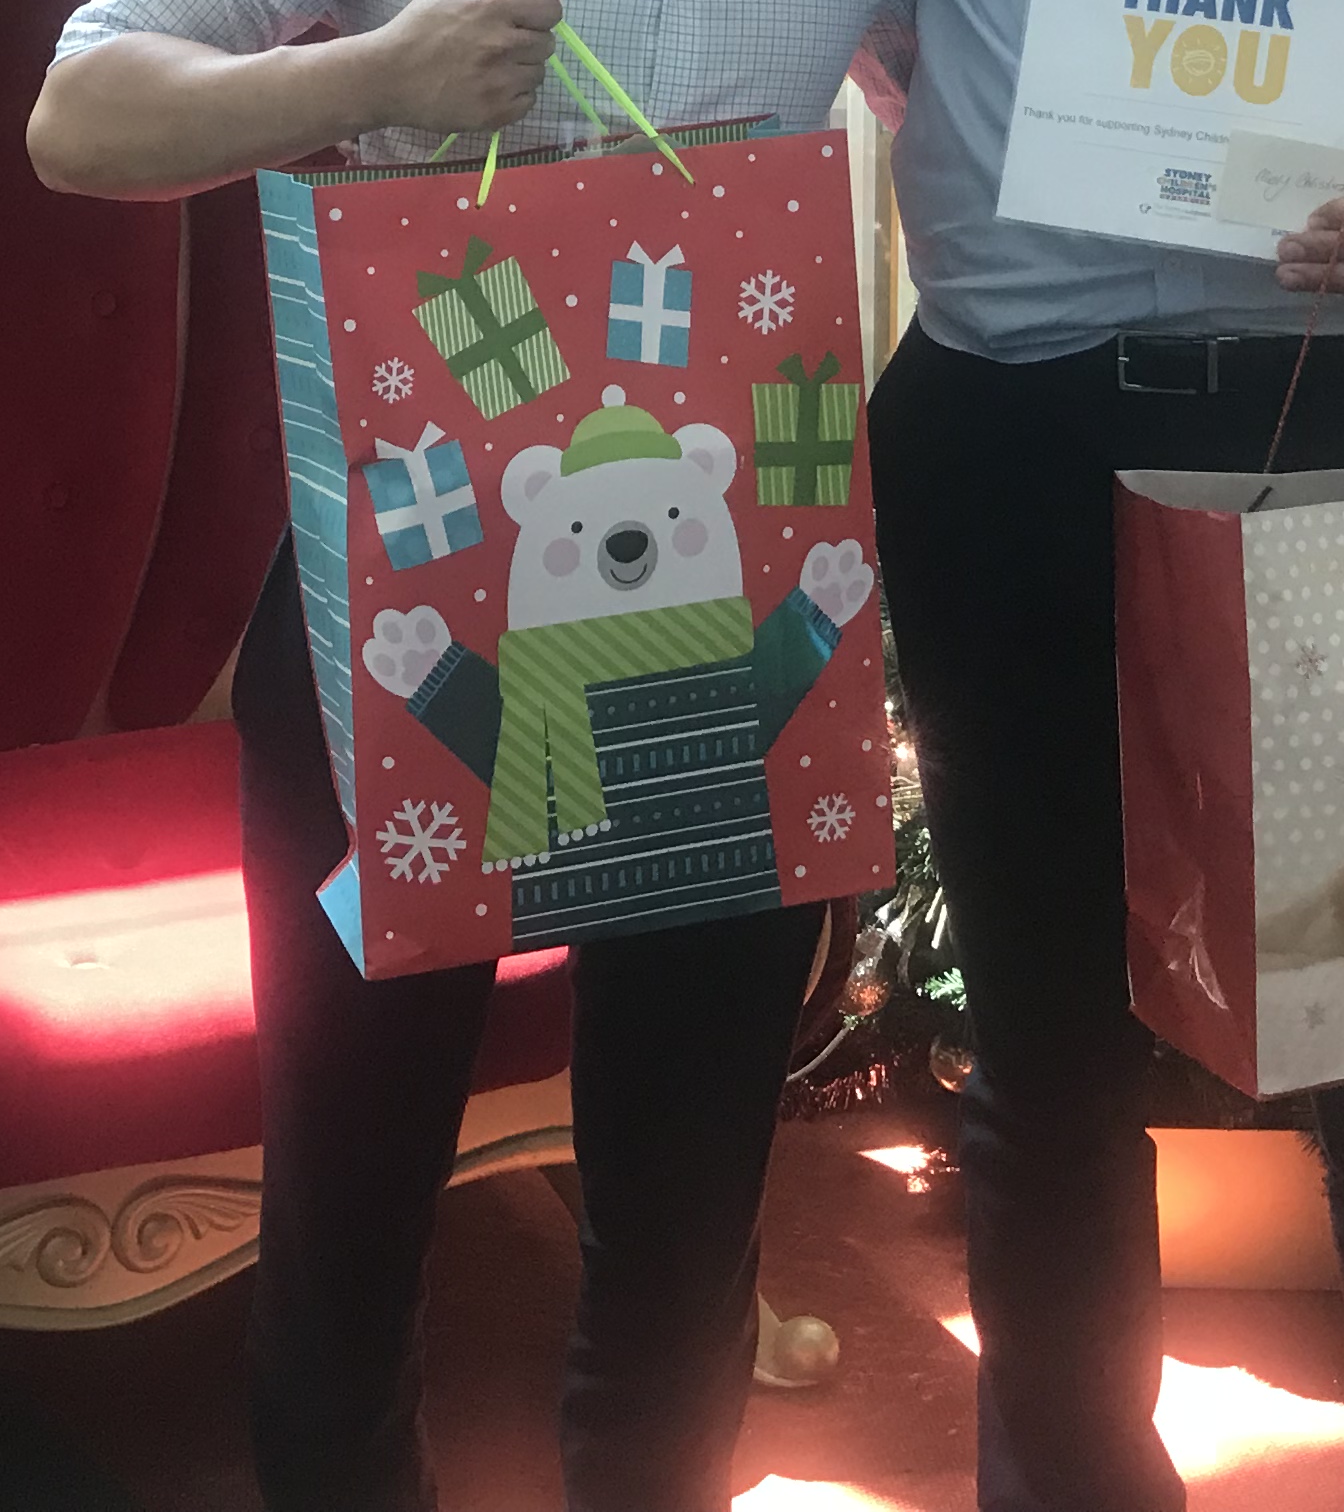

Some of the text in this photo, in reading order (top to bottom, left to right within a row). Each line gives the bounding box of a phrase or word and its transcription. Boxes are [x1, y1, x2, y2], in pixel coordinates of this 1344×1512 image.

[1122, 14, 1291, 104] YOU
[1023, 105, 1054, 121] Thank
[1057, 112, 1076, 124] you
[1078, 114, 1093, 126] for
[1096, 118, 1150, 136] supporting
[1154, 124, 1192, 142] Sydney
[1163, 168, 1212, 183] SYDNEY
[1160, 185, 1211, 200] HOSPITAL
